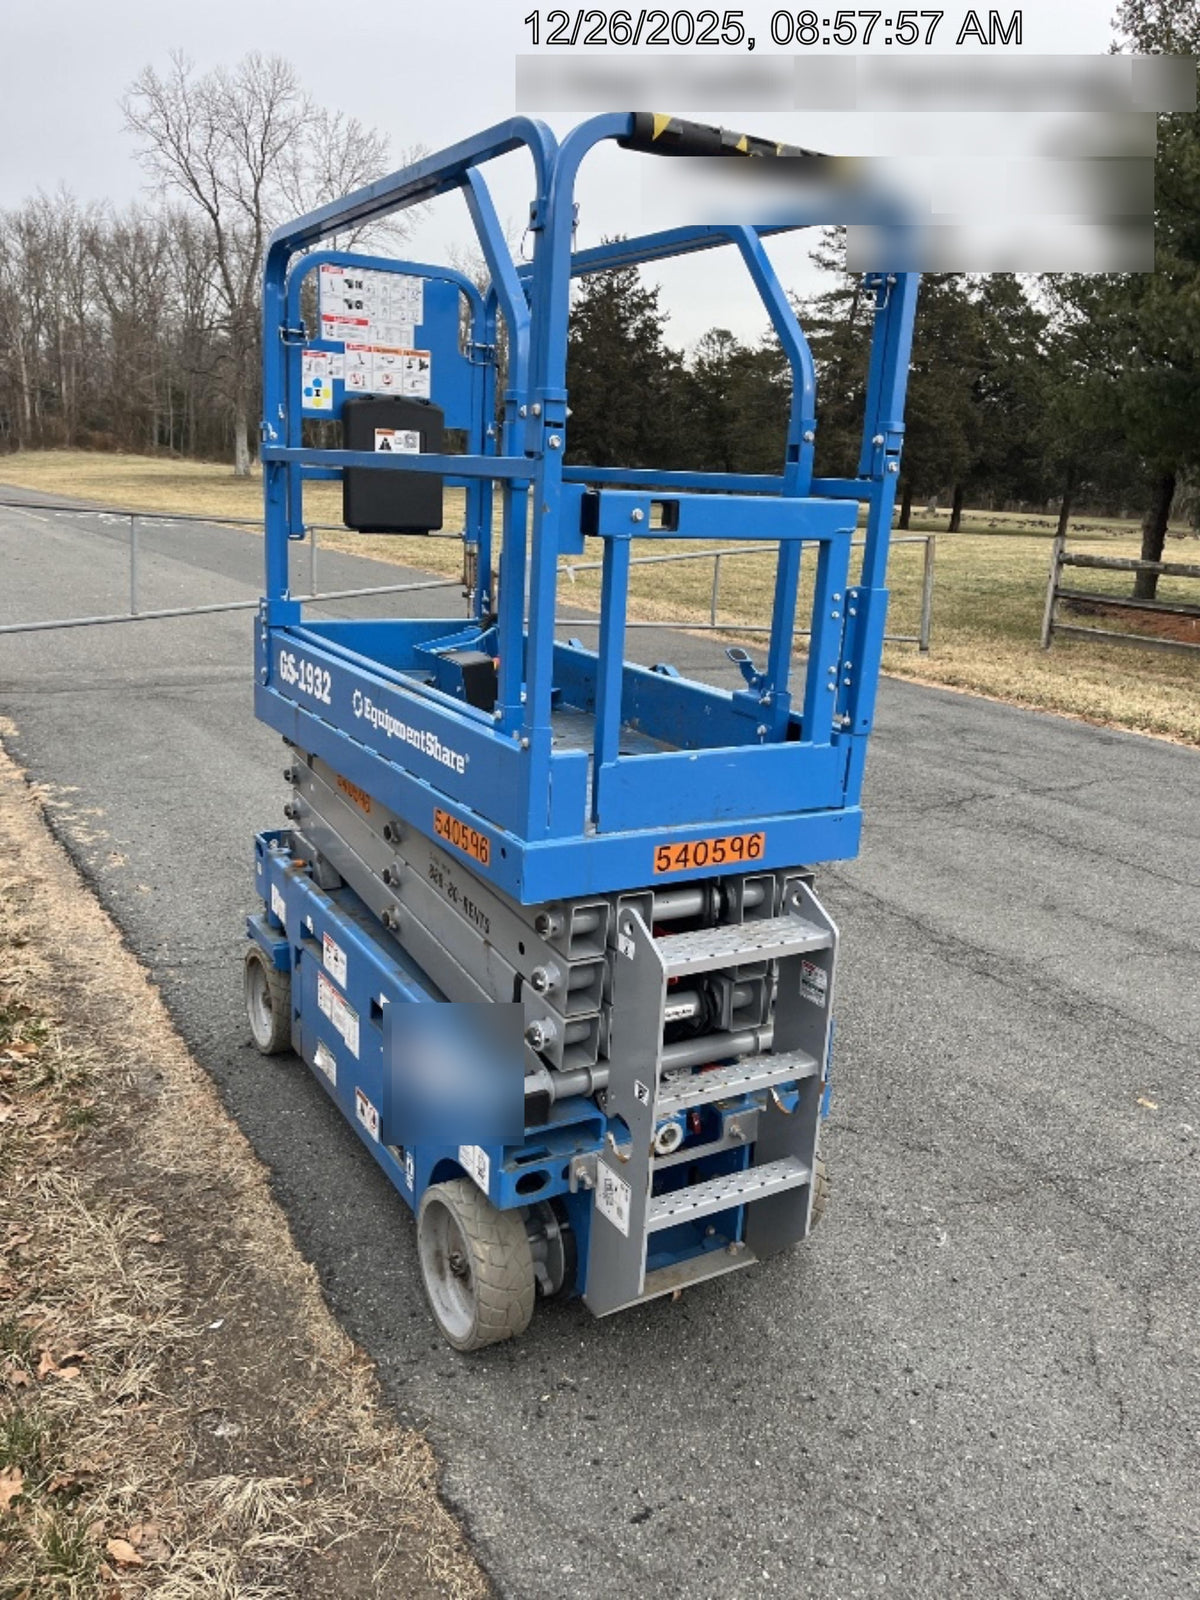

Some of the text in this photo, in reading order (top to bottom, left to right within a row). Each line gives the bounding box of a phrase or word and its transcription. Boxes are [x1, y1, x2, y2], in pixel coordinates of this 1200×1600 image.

[280, 650, 332, 705] GS-1932
[363, 697, 465, 774] EquipmentShare
[433, 809, 489, 863] 540596
[656, 833, 761, 871] 540596
